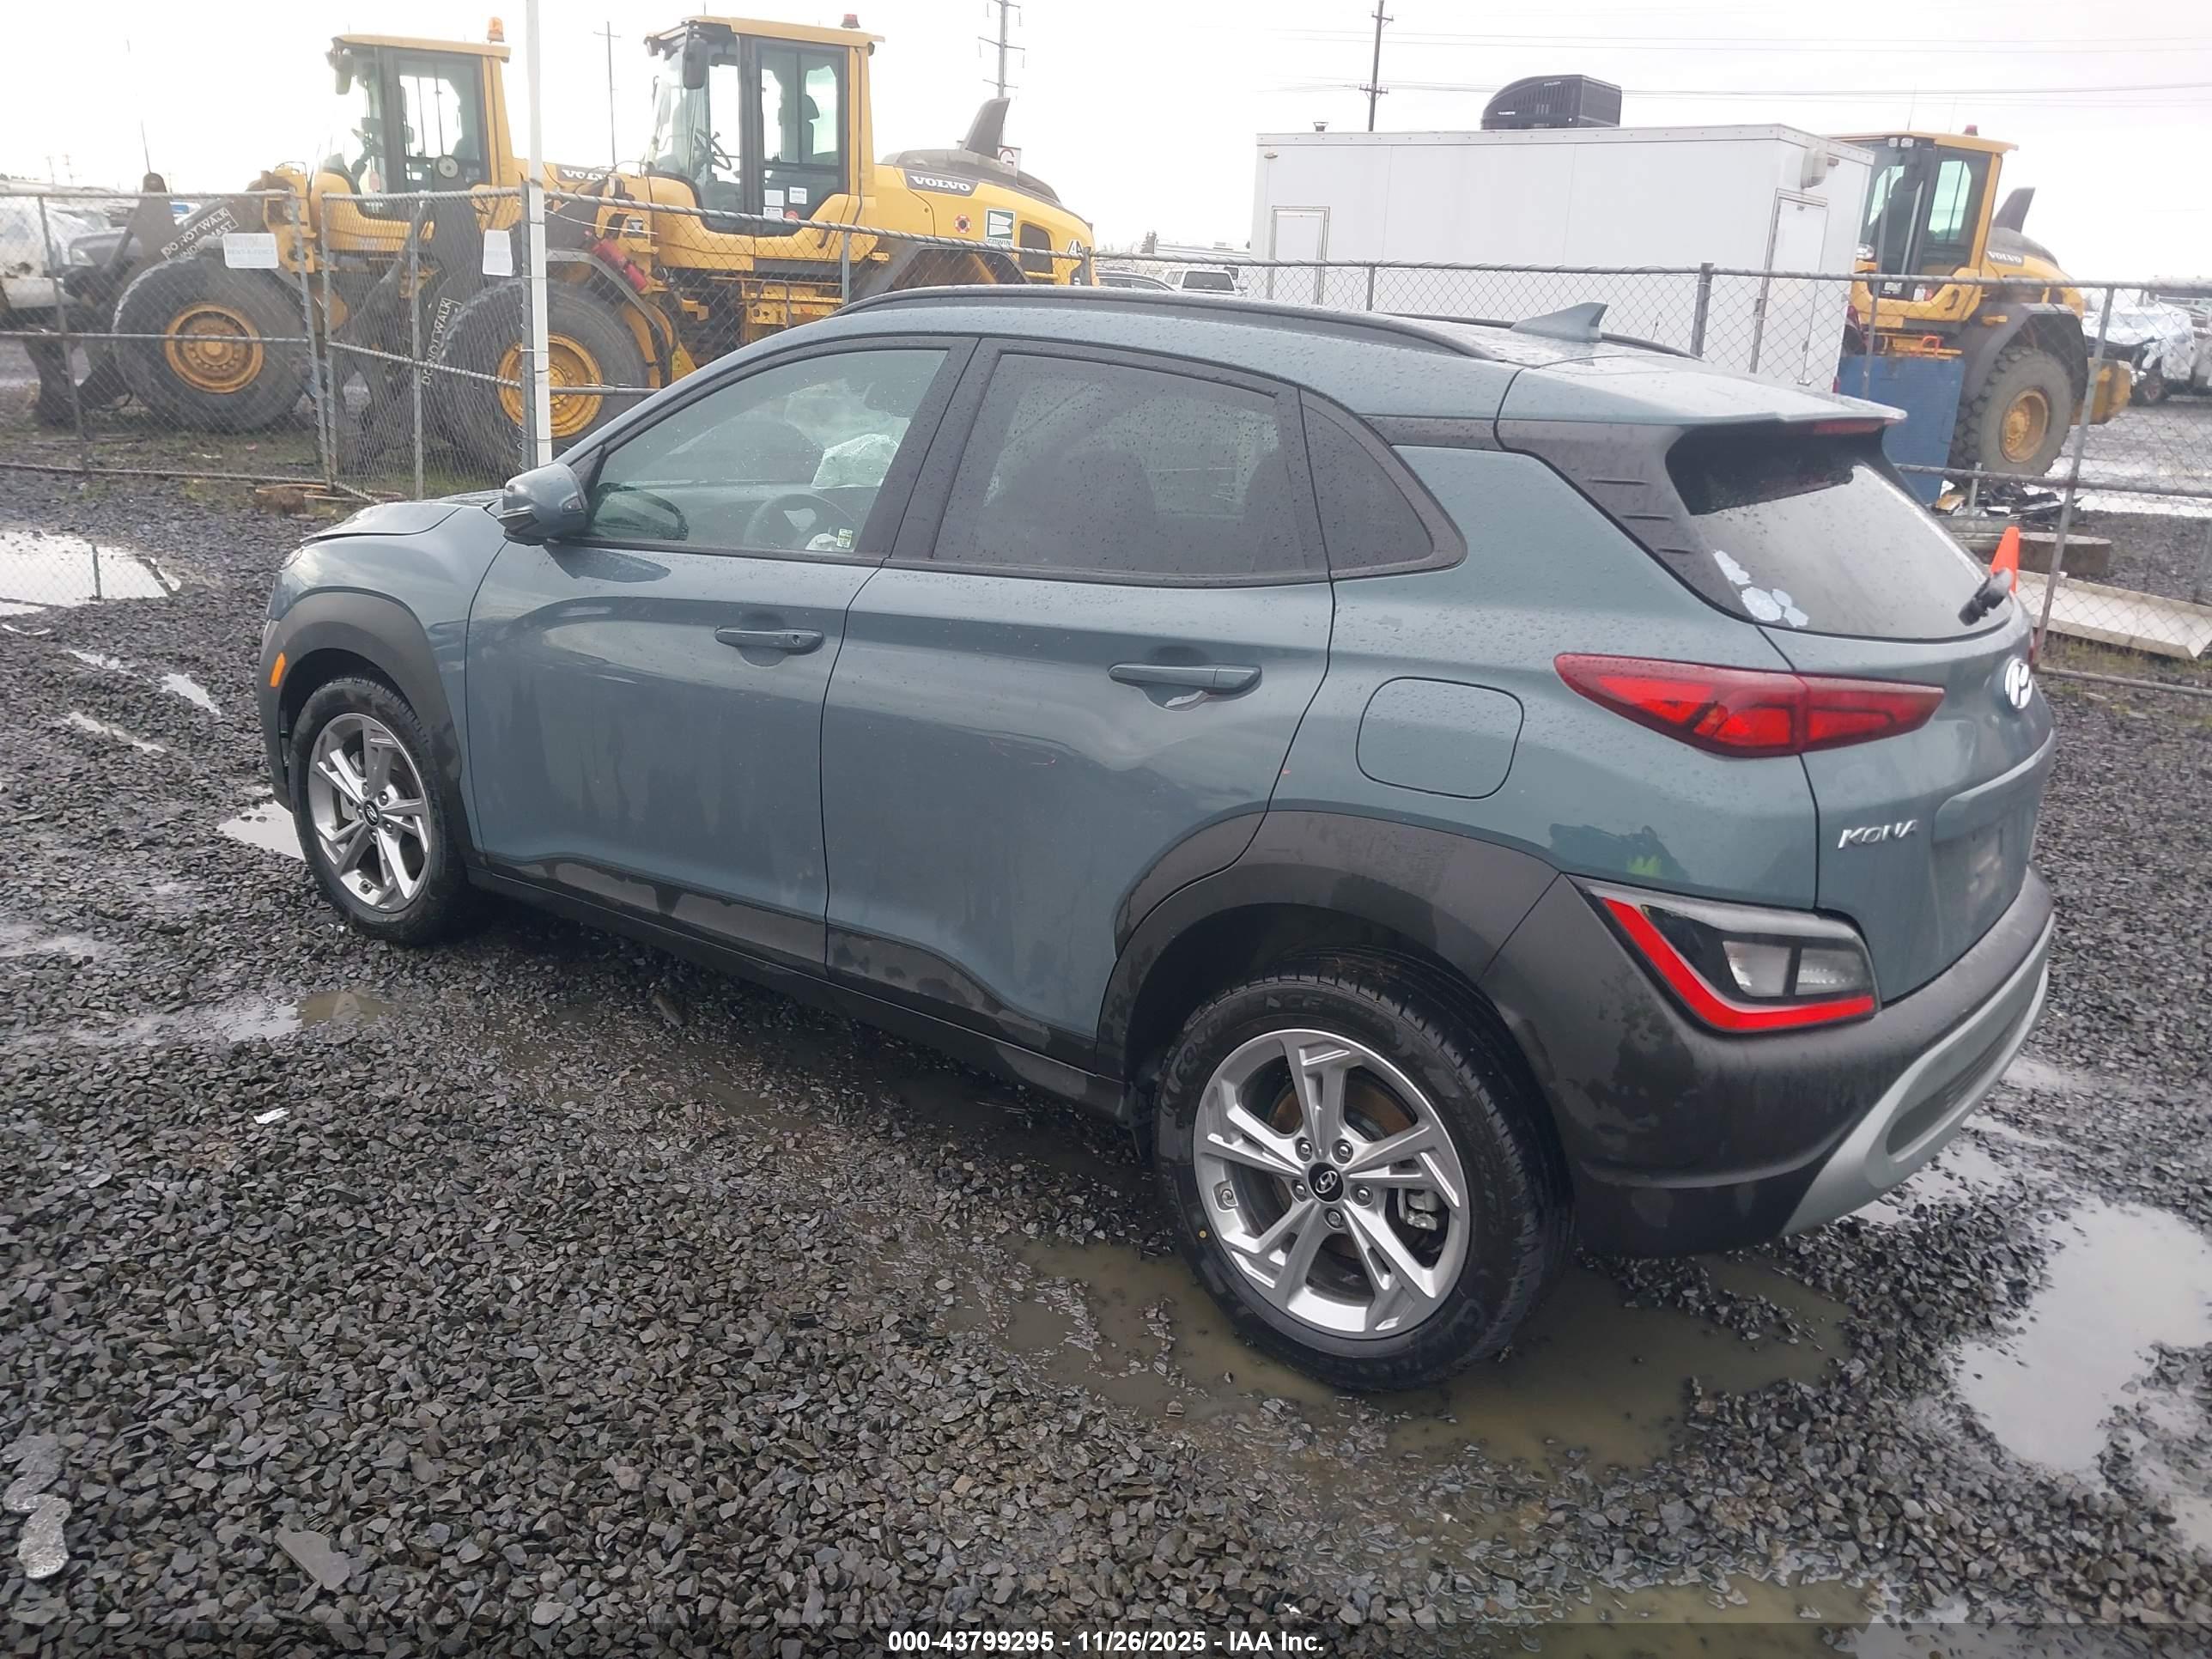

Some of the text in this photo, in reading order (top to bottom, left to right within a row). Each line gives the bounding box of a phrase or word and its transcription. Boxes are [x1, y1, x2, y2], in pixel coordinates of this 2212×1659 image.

[909, 175, 971, 191] VOLVO
[161, 207, 229, 256] DO NOT WALK
[1987, 251, 2022, 263] VOLVO
[434, 298, 452, 334] WALK
[1838, 818, 1918, 849] KONA
